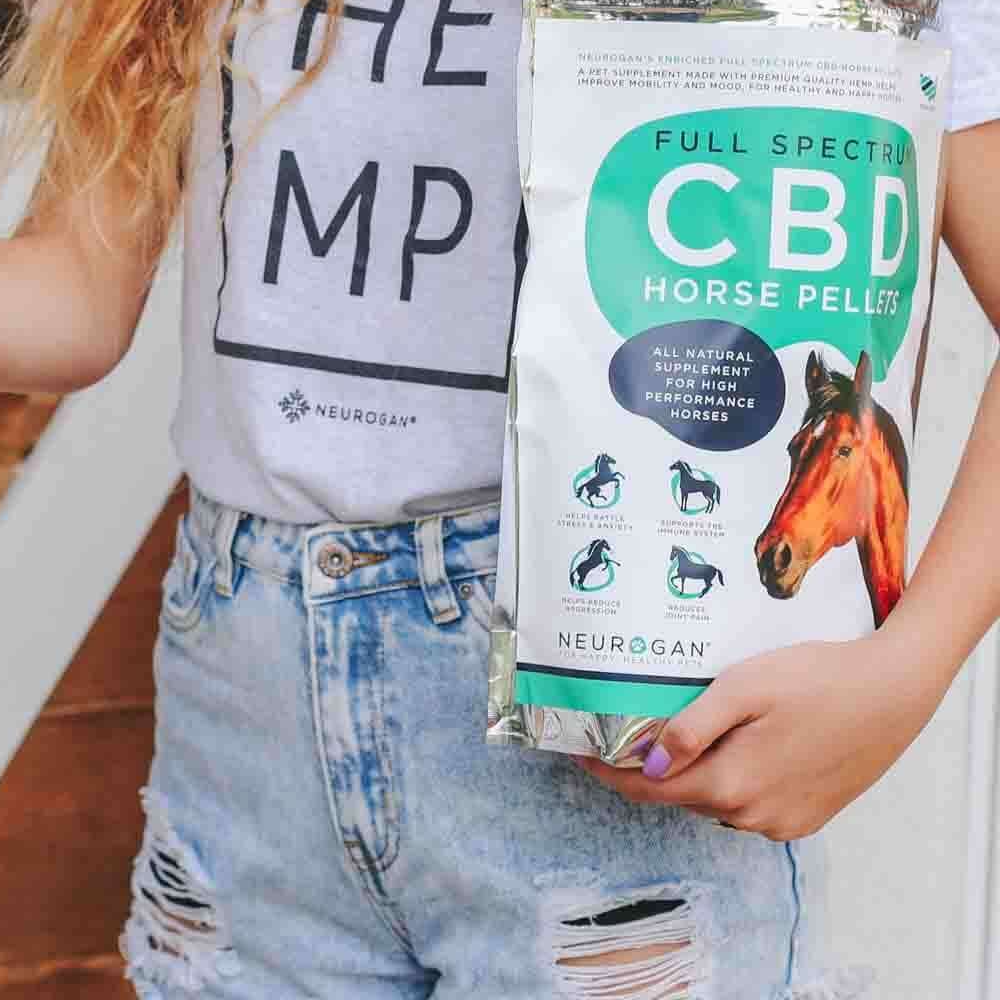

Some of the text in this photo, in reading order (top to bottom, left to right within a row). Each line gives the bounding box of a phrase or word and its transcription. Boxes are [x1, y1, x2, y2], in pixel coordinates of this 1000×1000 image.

[658, 55, 715, 65] ENRICHED
[720, 56, 745, 66] FULL
[751, 57, 811, 70] SPECTRUM
[577, 67, 585, 77] A
[589, 67, 608, 77] PET
[613, 68, 681, 79] SUPPLEMENT
[686, 71, 716, 80] MADE
[719, 71, 747, 81] WITH
[751, 72, 800, 84] PREMIUM
[804, 75, 845, 88] QUALITY
[577, 78, 625, 88] IMPROVE
[629, 79, 680, 89] MOBILITY
[683, 80, 706, 89] AND
[749, 82, 770, 92] FOR
[776, 83, 820, 95] HEALTHY
[825, 87, 845, 97] AND
[655, 130, 912, 167] FULL SPECTRU
[263, 149, 473, 301] MP
[646, 162, 909, 278] CBD
[643, 276, 900, 316] HORSE PELLETS
[653, 346, 753, 362] ALL NATURAL
[655, 361, 750, 377] SUPPLEMENT
[665, 378, 737, 392] FOR HIGH
[645, 391, 756, 409] PERFORMANCE
[670, 408, 729, 422] HORSES
